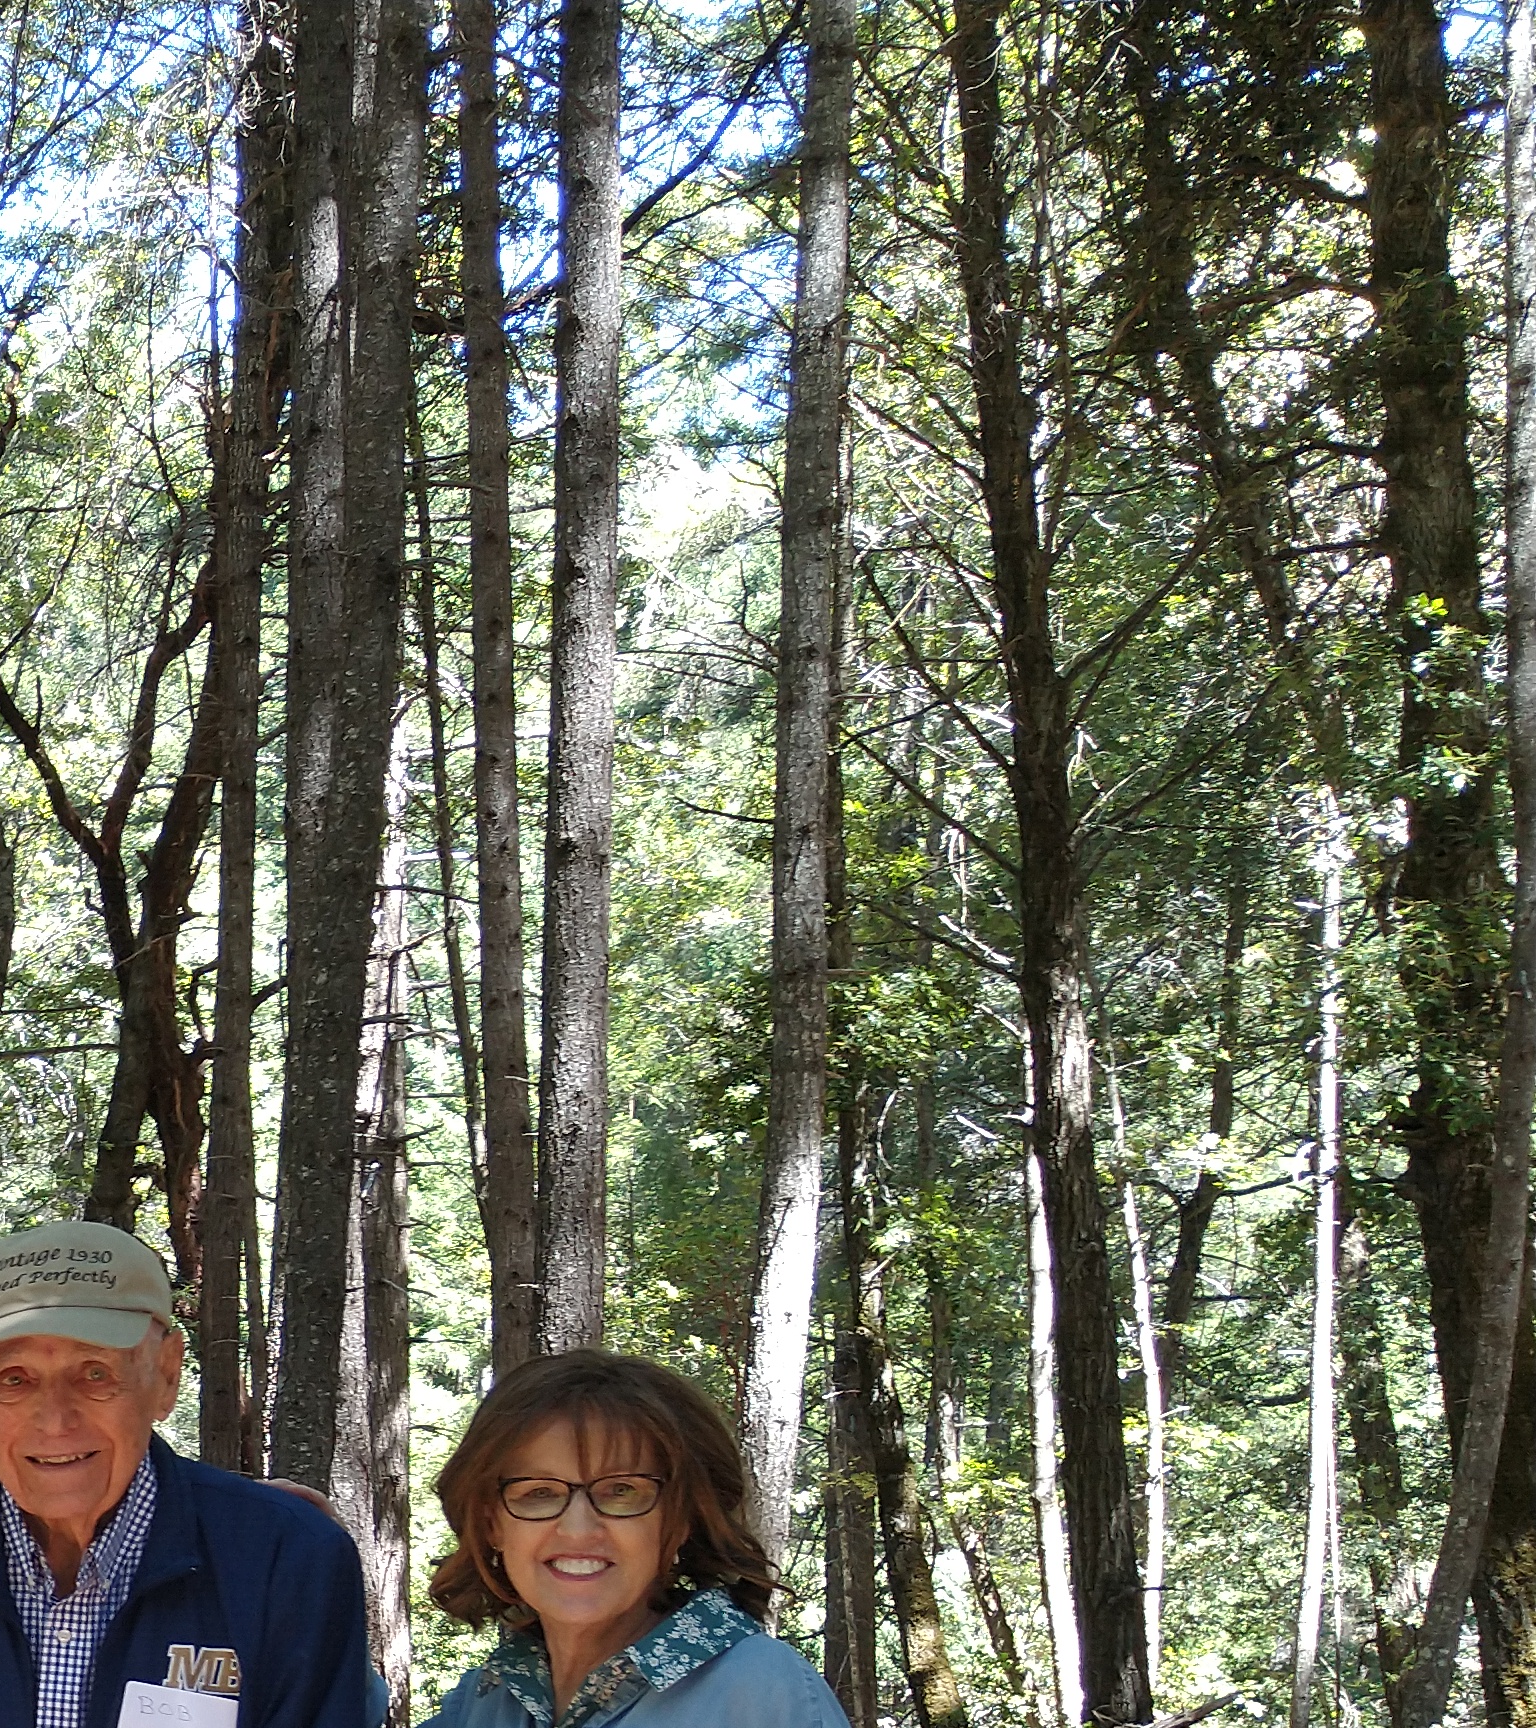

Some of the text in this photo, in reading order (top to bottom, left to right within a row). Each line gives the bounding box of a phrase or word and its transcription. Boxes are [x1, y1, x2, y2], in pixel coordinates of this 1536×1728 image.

[66, 1247, 113, 1265] 1930
[28, 1267, 117, 1290] Perfectly
[138, 1695, 192, 1722] BOB
